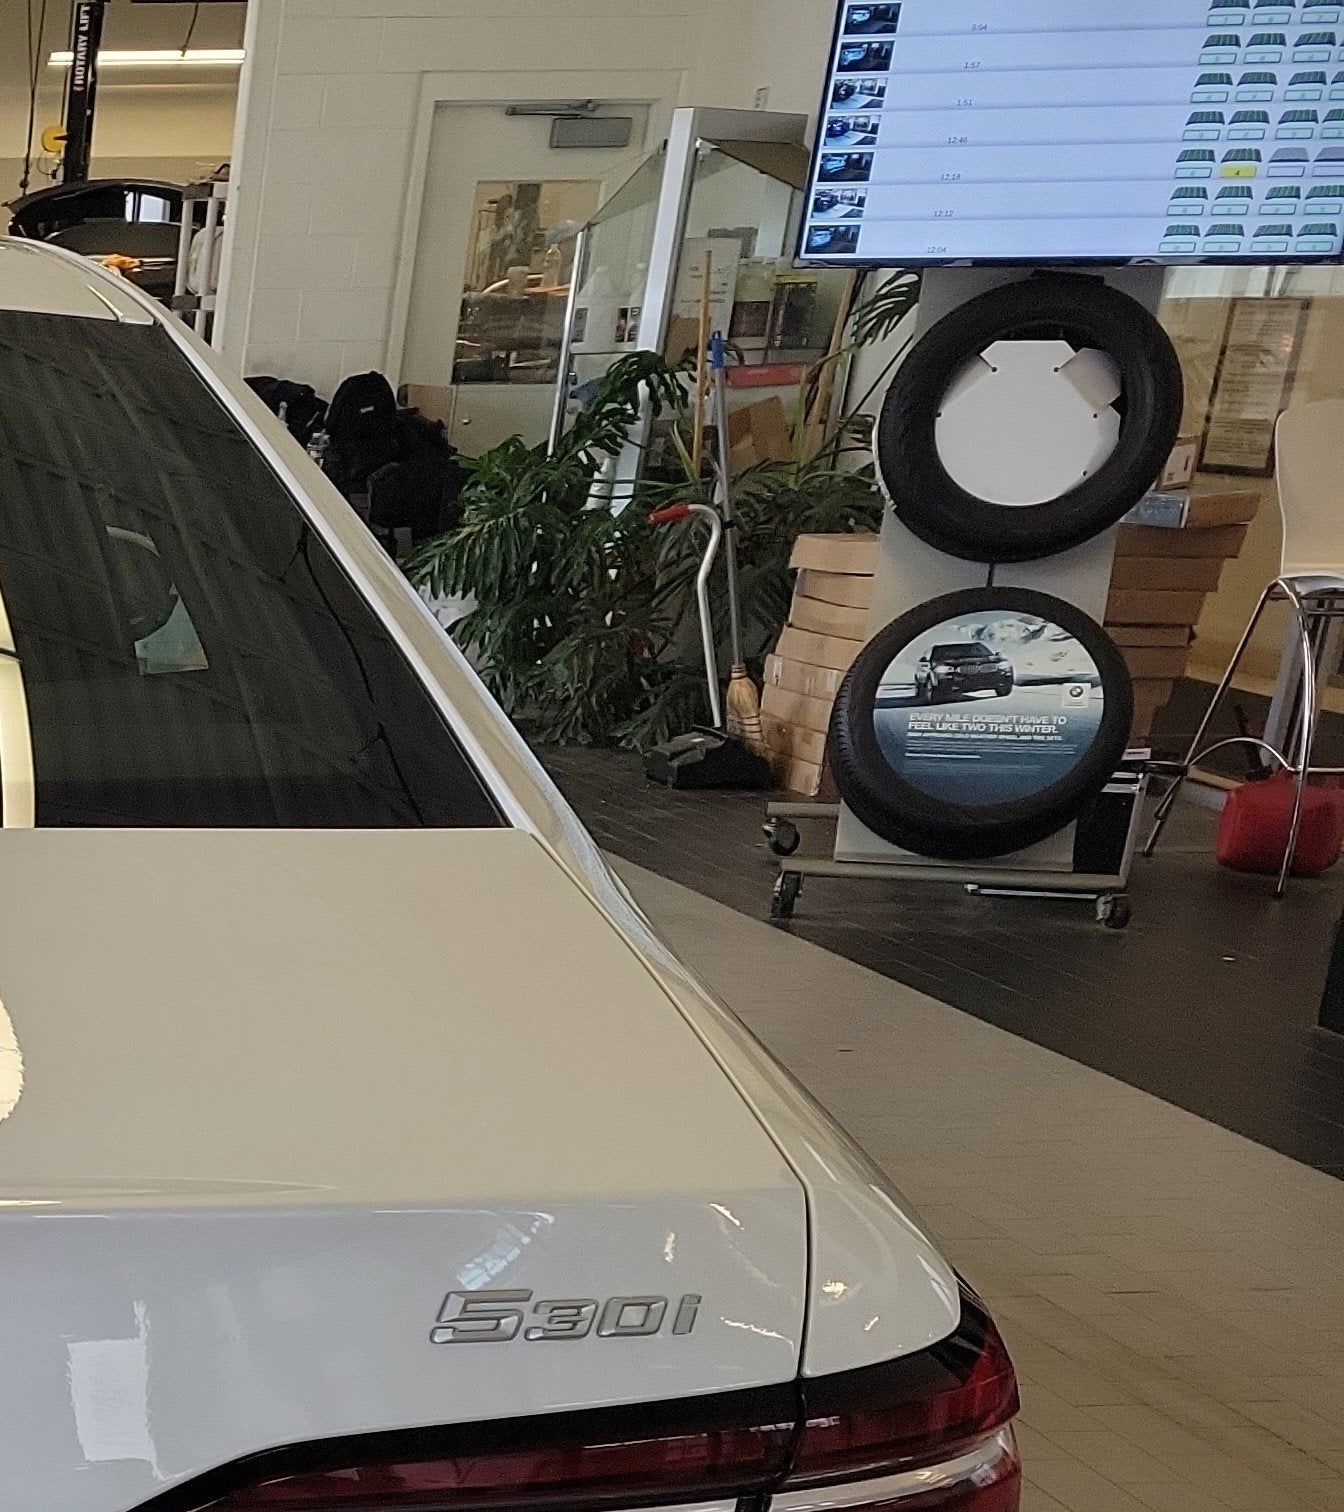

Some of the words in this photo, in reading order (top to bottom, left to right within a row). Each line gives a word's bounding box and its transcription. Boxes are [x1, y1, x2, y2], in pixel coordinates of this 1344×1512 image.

[79, 5, 91, 31] LIFT
[74, 35, 89, 85] ROTARY
[908, 721, 934, 730] FEEL
[936, 722, 959, 731] LIKE
[961, 723, 987, 732] TWO
[988, 723, 1013, 732] THIS
[1014, 724, 1058, 733] WINTER.
[910, 713, 944, 721] EVERY
[945, 714, 970, 722] MILE
[972, 714, 1018, 723] DOESN'T
[1019, 715, 1050, 724] HAVE
[1052, 716, 1067, 725] TO
[429, 1288, 703, 1344] 530i
